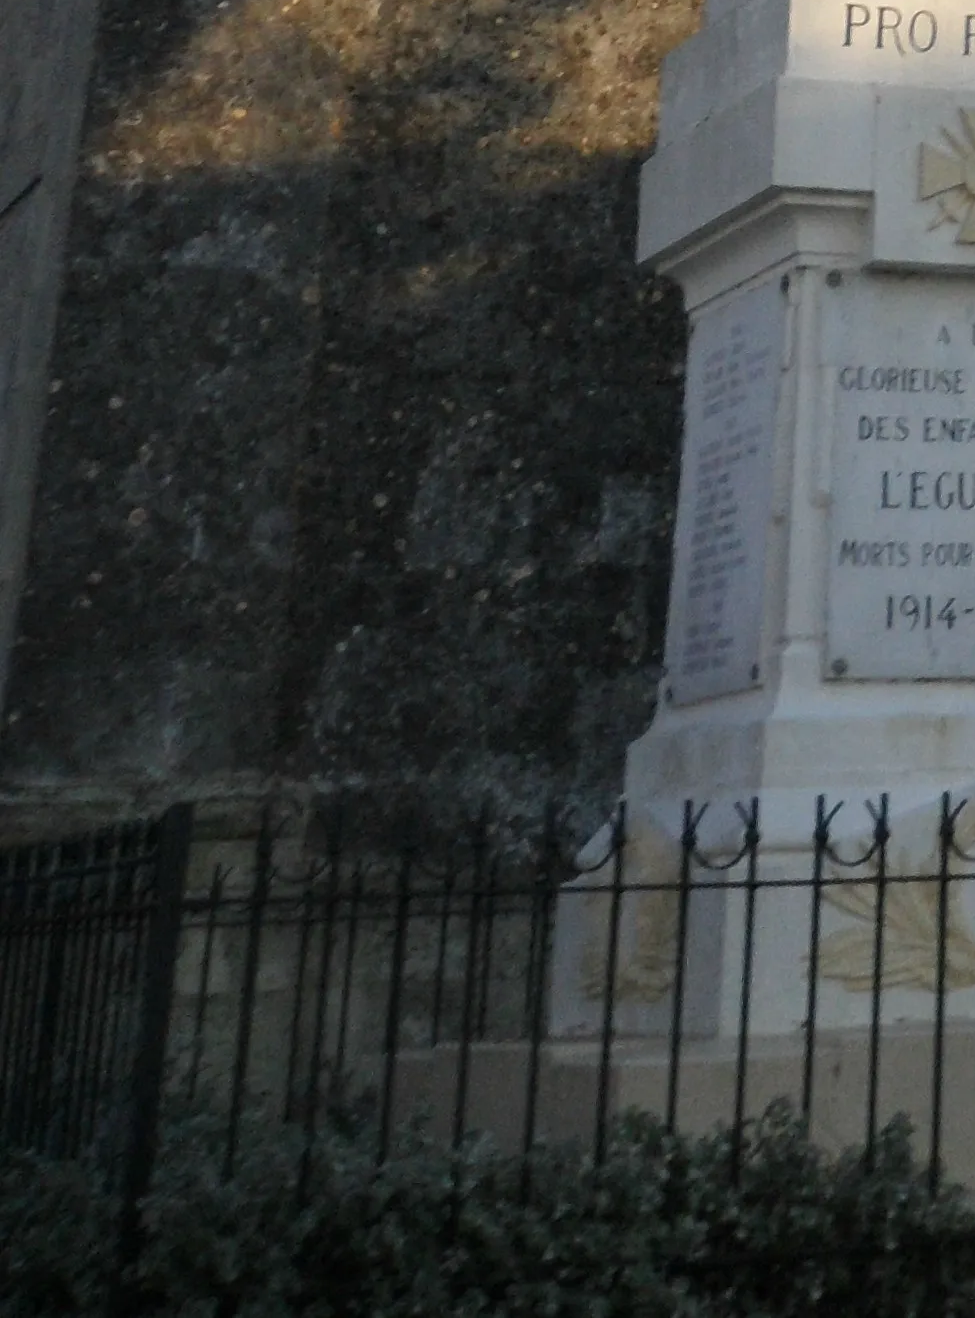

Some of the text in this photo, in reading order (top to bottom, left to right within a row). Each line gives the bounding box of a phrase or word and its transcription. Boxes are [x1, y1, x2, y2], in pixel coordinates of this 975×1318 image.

[842, 3, 938, 57] PRO
[936, 325, 951, 345] A
[840, 365, 966, 395] GLORIEUSE
[857, 414, 910, 443] DES
[838, 538, 910, 568] MORTS
[921, 540, 974, 568] POUR
